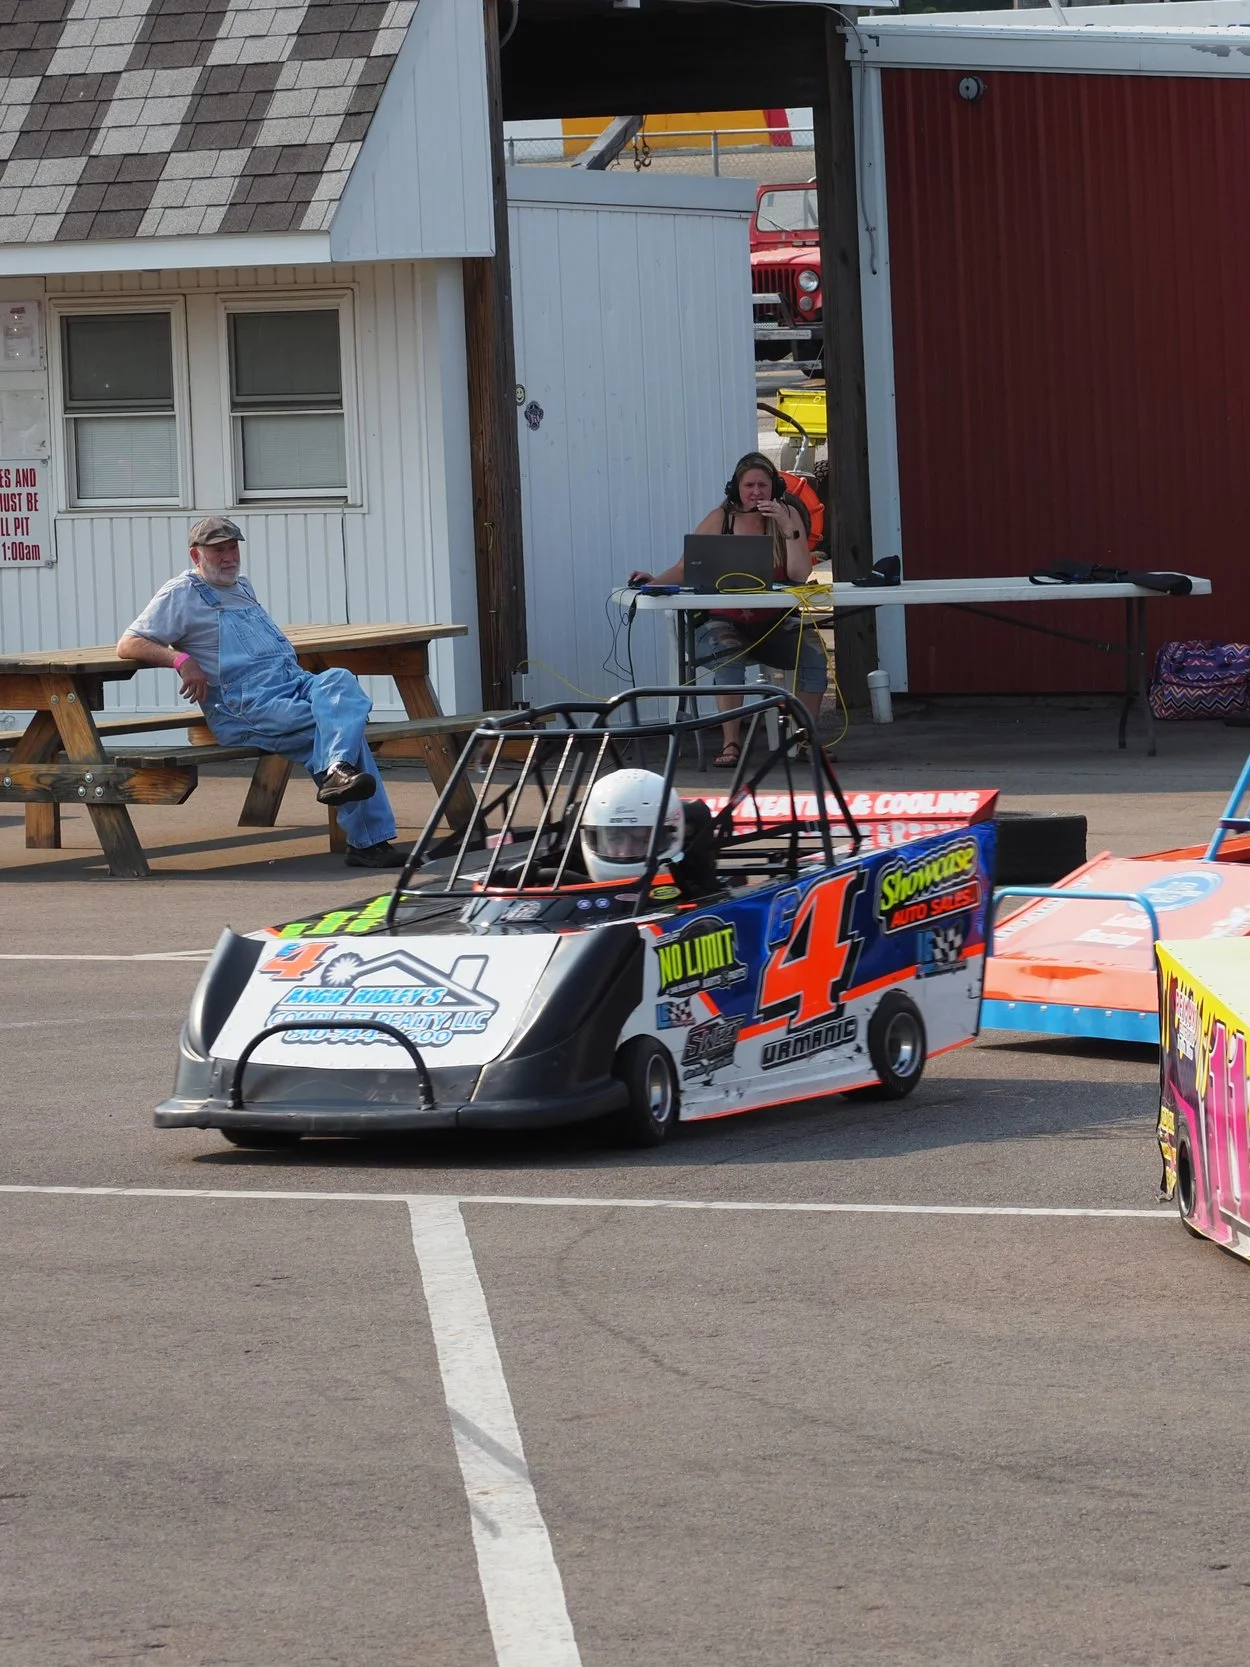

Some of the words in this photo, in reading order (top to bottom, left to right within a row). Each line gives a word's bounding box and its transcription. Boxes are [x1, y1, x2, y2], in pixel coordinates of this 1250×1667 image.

[15, 468, 36, 488] AND
[26, 492, 39, 512] BE
[14, 516, 30, 536] PIT
[2, 542, 41, 561] 1:00am
[873, 792, 980, 815] COOLING
[880, 848, 975, 911] Showcase
[890, 903, 928, 929] AUTO
[930, 889, 973, 916] SALES
[659, 943, 683, 989] NO
[684, 928, 734, 977] LIMIT
[760, 870, 858, 1027] 4
[259, 942, 335, 981] 4
[279, 987, 352, 1006] ANGIE
[348, 986, 448, 1006] RIDLEY'S
[450, 1010, 493, 1031] LLC
